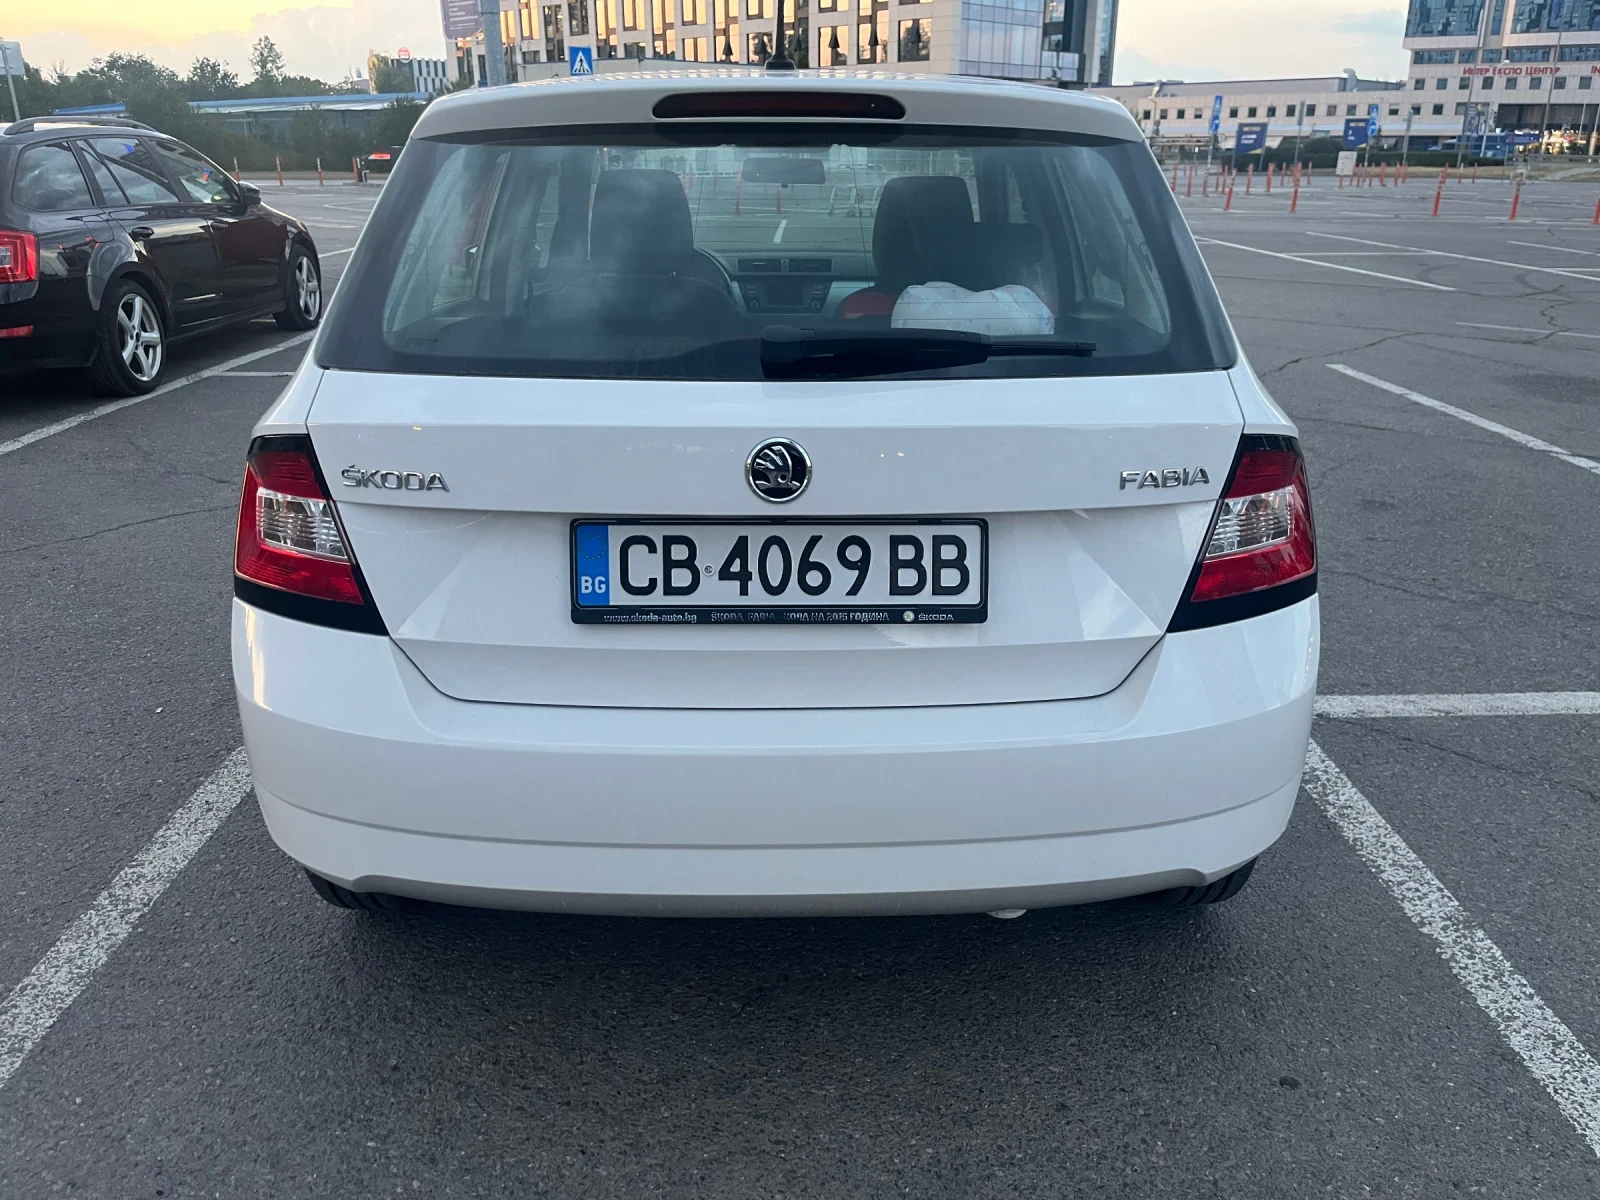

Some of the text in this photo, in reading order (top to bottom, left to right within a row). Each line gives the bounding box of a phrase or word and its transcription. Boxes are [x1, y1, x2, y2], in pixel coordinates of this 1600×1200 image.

[1492, 66, 1522, 75] ЕКСПО
[341, 464, 450, 492] ŠKODA
[1120, 466, 1210, 490] FABIA
[619, 534, 970, 596] CB 4069 BB
[581, 576, 606, 594] BG
[603, 612, 698, 623] www.skoda-auto.bg
[918, 613, 954, 621] ŠKODA
